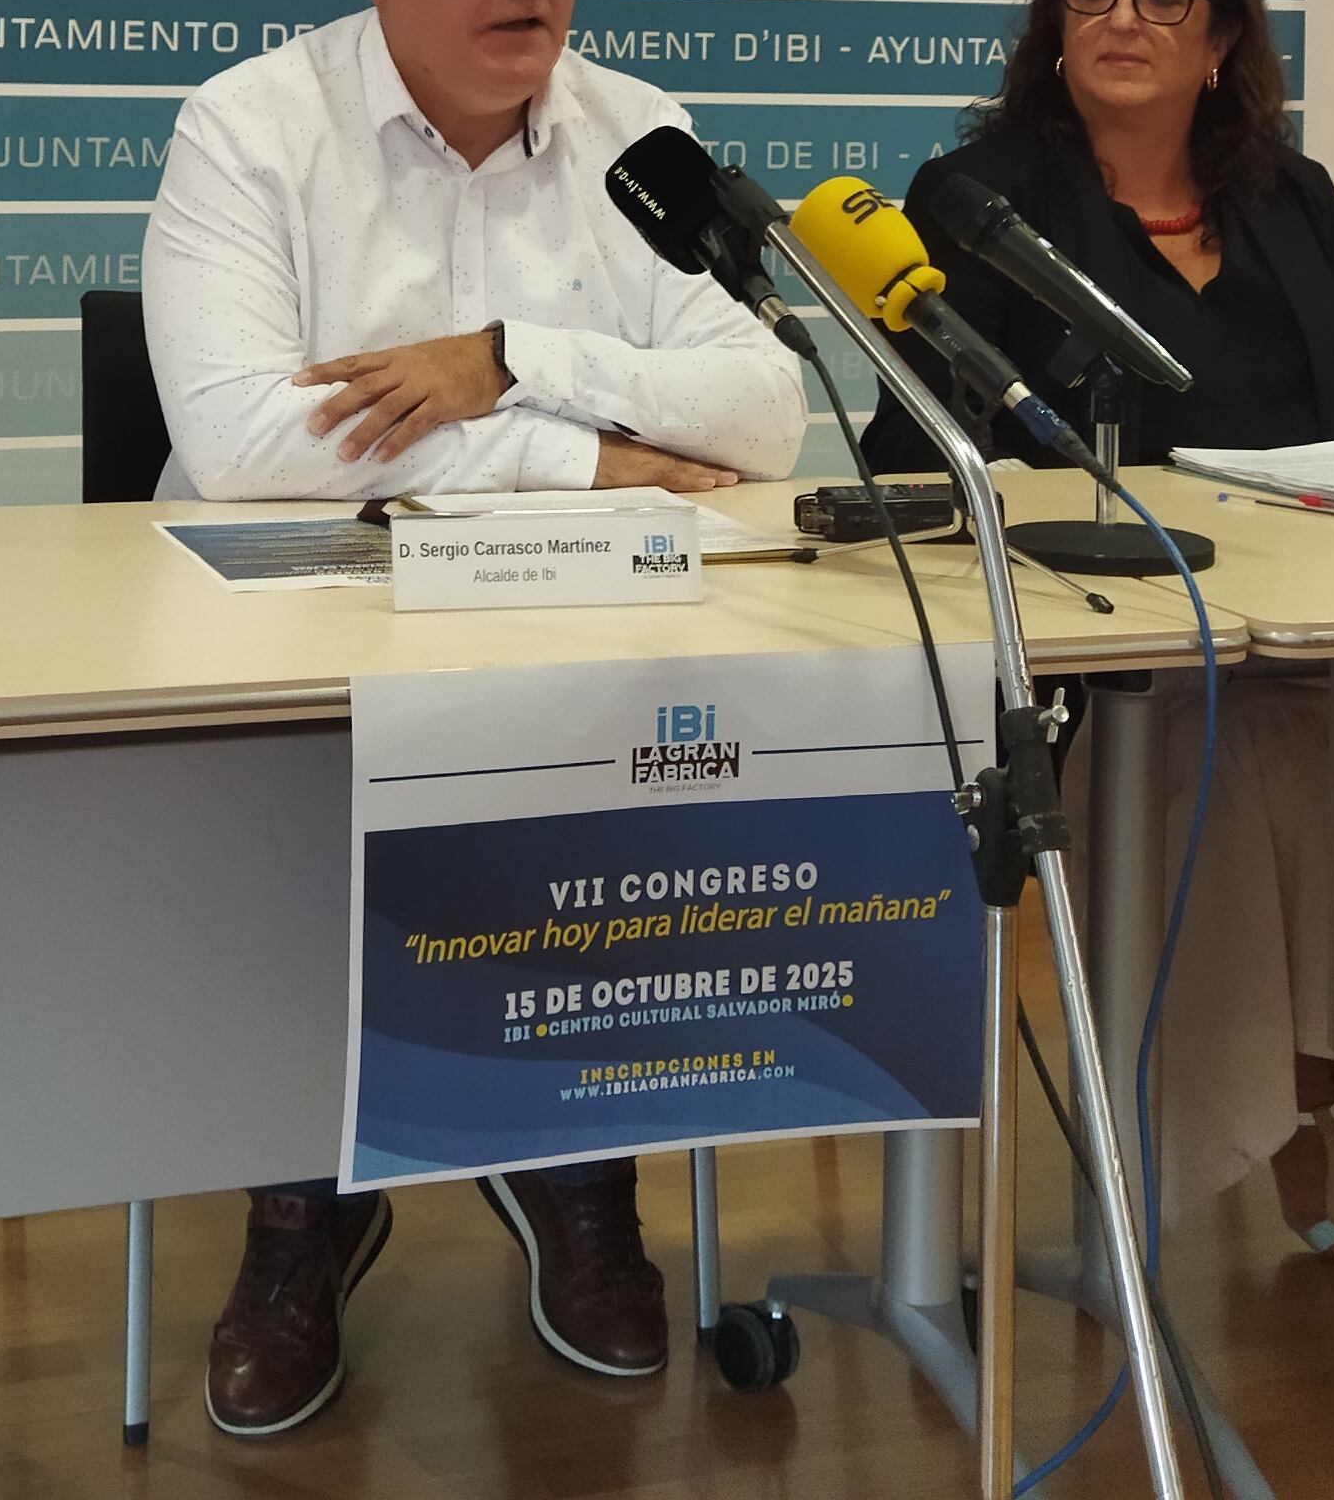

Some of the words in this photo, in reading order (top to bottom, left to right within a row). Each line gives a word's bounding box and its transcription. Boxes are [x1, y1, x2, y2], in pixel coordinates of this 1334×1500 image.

[735, 29, 820, 63] D'IBI
[767, 141, 813, 169] DE
[833, 141, 878, 170] IBI
[399, 543, 415, 558] D.
[420, 542, 470, 561] Sergio
[474, 541, 543, 556] Carrasco
[547, 539, 611, 554] Martínez
[473, 568, 519, 583] Alcalde
[522, 568, 538, 582] de
[542, 567, 557, 581] Ibi
[549, 877, 605, 911] VII
[620, 861, 818, 903] CONGRESO
[405, 928, 537, 964] “Innovar
[543, 918, 600, 953] hoy
[604, 914, 672, 950] para
[680, 902, 778, 934] liderar
[784, 896, 812, 927] el
[818, 889, 952, 925] mañana”
[504, 990, 536, 1020] 15
[546, 984, 582, 1015] DE
[592, 969, 730, 1008] OCTUBRE
[740, 965, 776, 994] DE
[785, 960, 853, 991] 2025
[504, 1024, 531, 1043] IBI
[548, 1014, 614, 1037] CENTRO
[619, 1006, 702, 1028] CULTURAL
[707, 998, 792, 1019] SALVADOR
[797, 994, 841, 1011] MIRÓ
